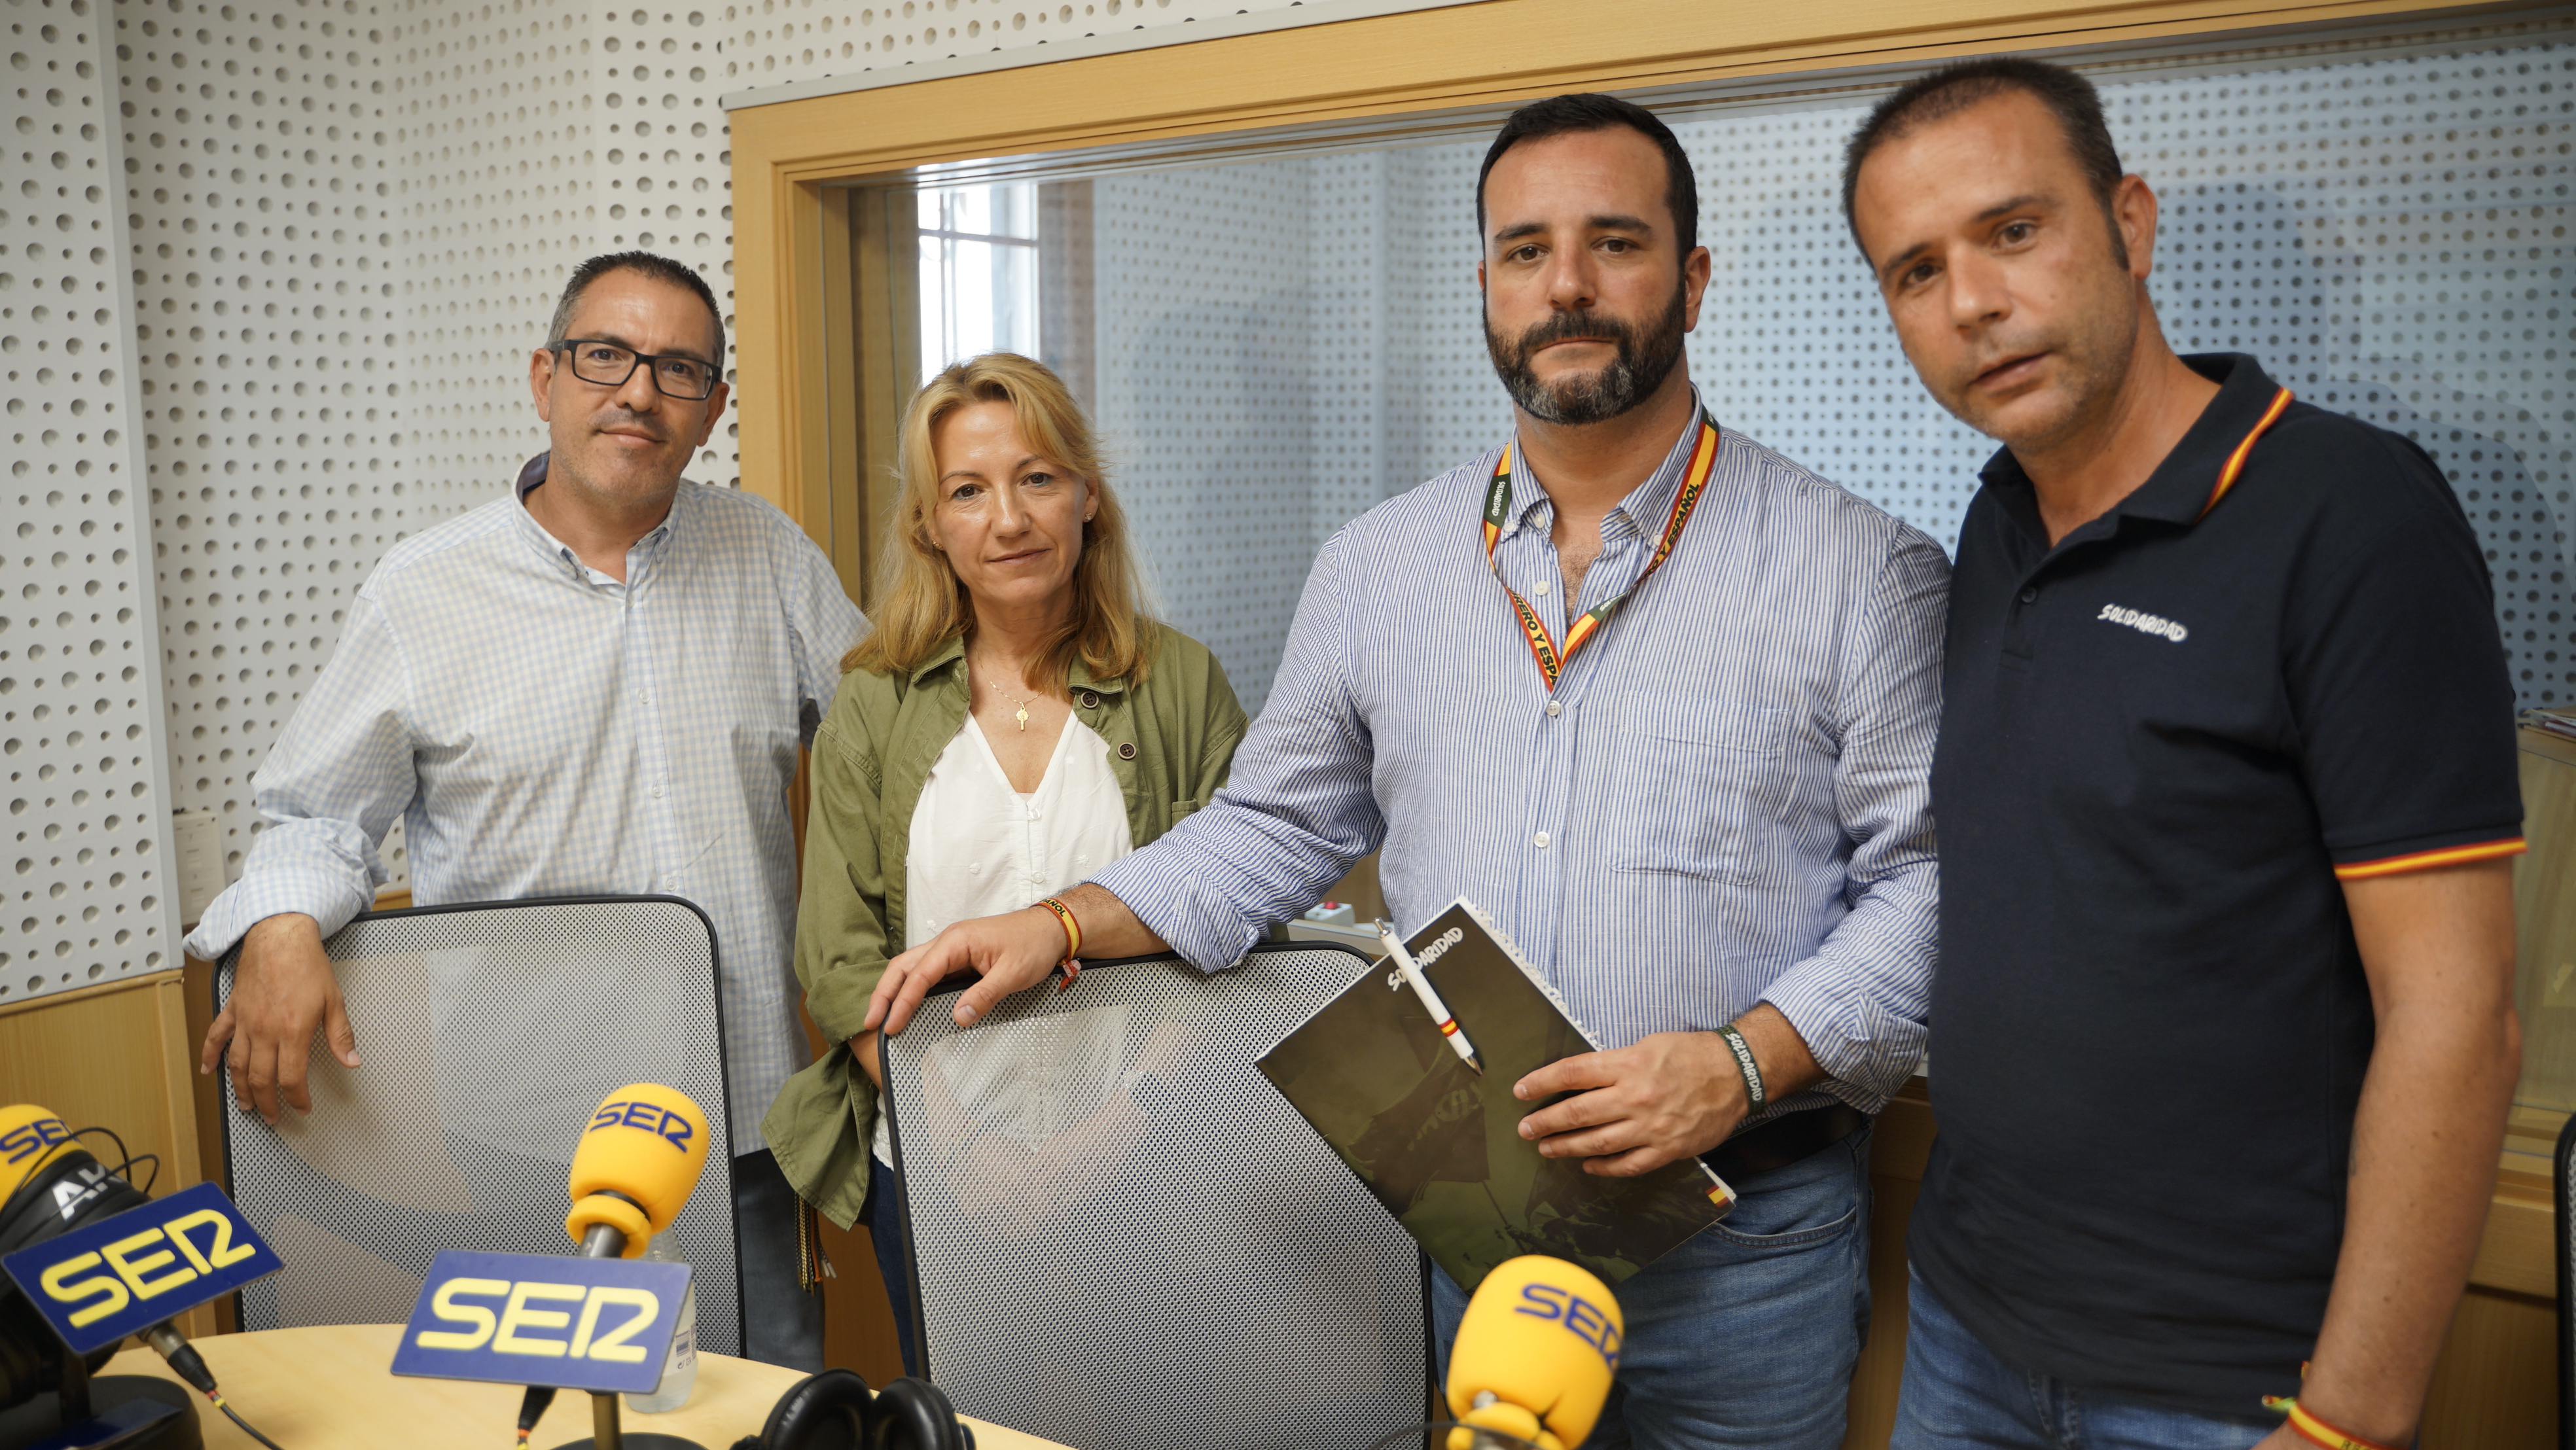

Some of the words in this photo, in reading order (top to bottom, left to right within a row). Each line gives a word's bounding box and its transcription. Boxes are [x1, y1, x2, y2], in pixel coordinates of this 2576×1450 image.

[1492, 481, 1506, 516] SOLIDARIDAD
[1659, 545, 1666, 556] Y
[1667, 484, 1700, 547] ESPAÑOL
[1533, 633, 1546, 643] Y
[2097, 603, 2189, 643] SOLIDARIDAD
[1387, 927, 1463, 991] SODARIDAD
[1725, 1033, 1762, 1101] SOLIDARIDAD
[589, 1102, 694, 1154] SER
[52, 1163, 124, 1222] AK
[41, 1209, 257, 1328] SER
[416, 1277, 660, 1363] SER
